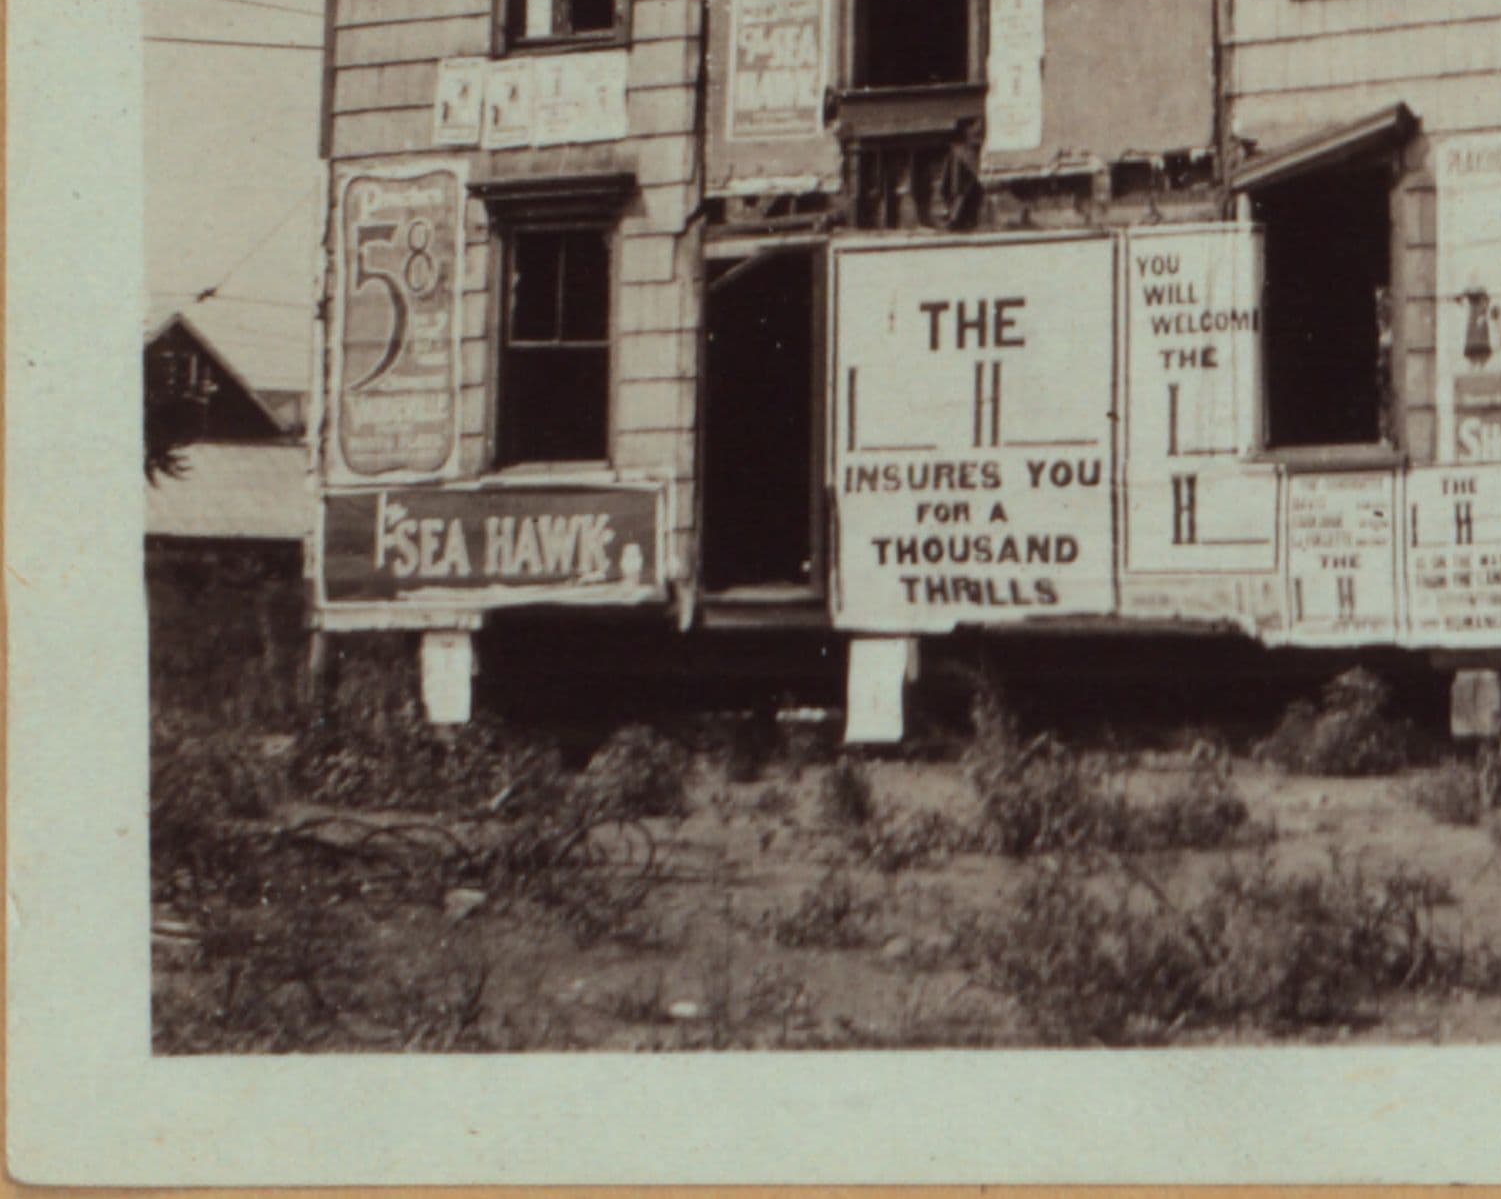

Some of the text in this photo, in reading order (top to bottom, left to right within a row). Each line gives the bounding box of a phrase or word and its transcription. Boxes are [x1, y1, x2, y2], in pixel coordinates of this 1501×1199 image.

[1136, 253, 1180, 277] YOU
[1143, 281, 1199, 306] WILL
[919, 298, 1026, 351] THE
[1158, 346, 1218, 370] THE
[844, 459, 1102, 493] INSURES YOU
[1441, 477, 1477, 495] THE
[916, 501, 1008, 524] FOR A
[392, 518, 473, 578] SEA
[484, 514, 613, 578] HAWK
[872, 535, 1079, 566] THOUSAND
[1321, 554, 1360, 569] THE
[900, 575, 1059, 605] THRILLS
